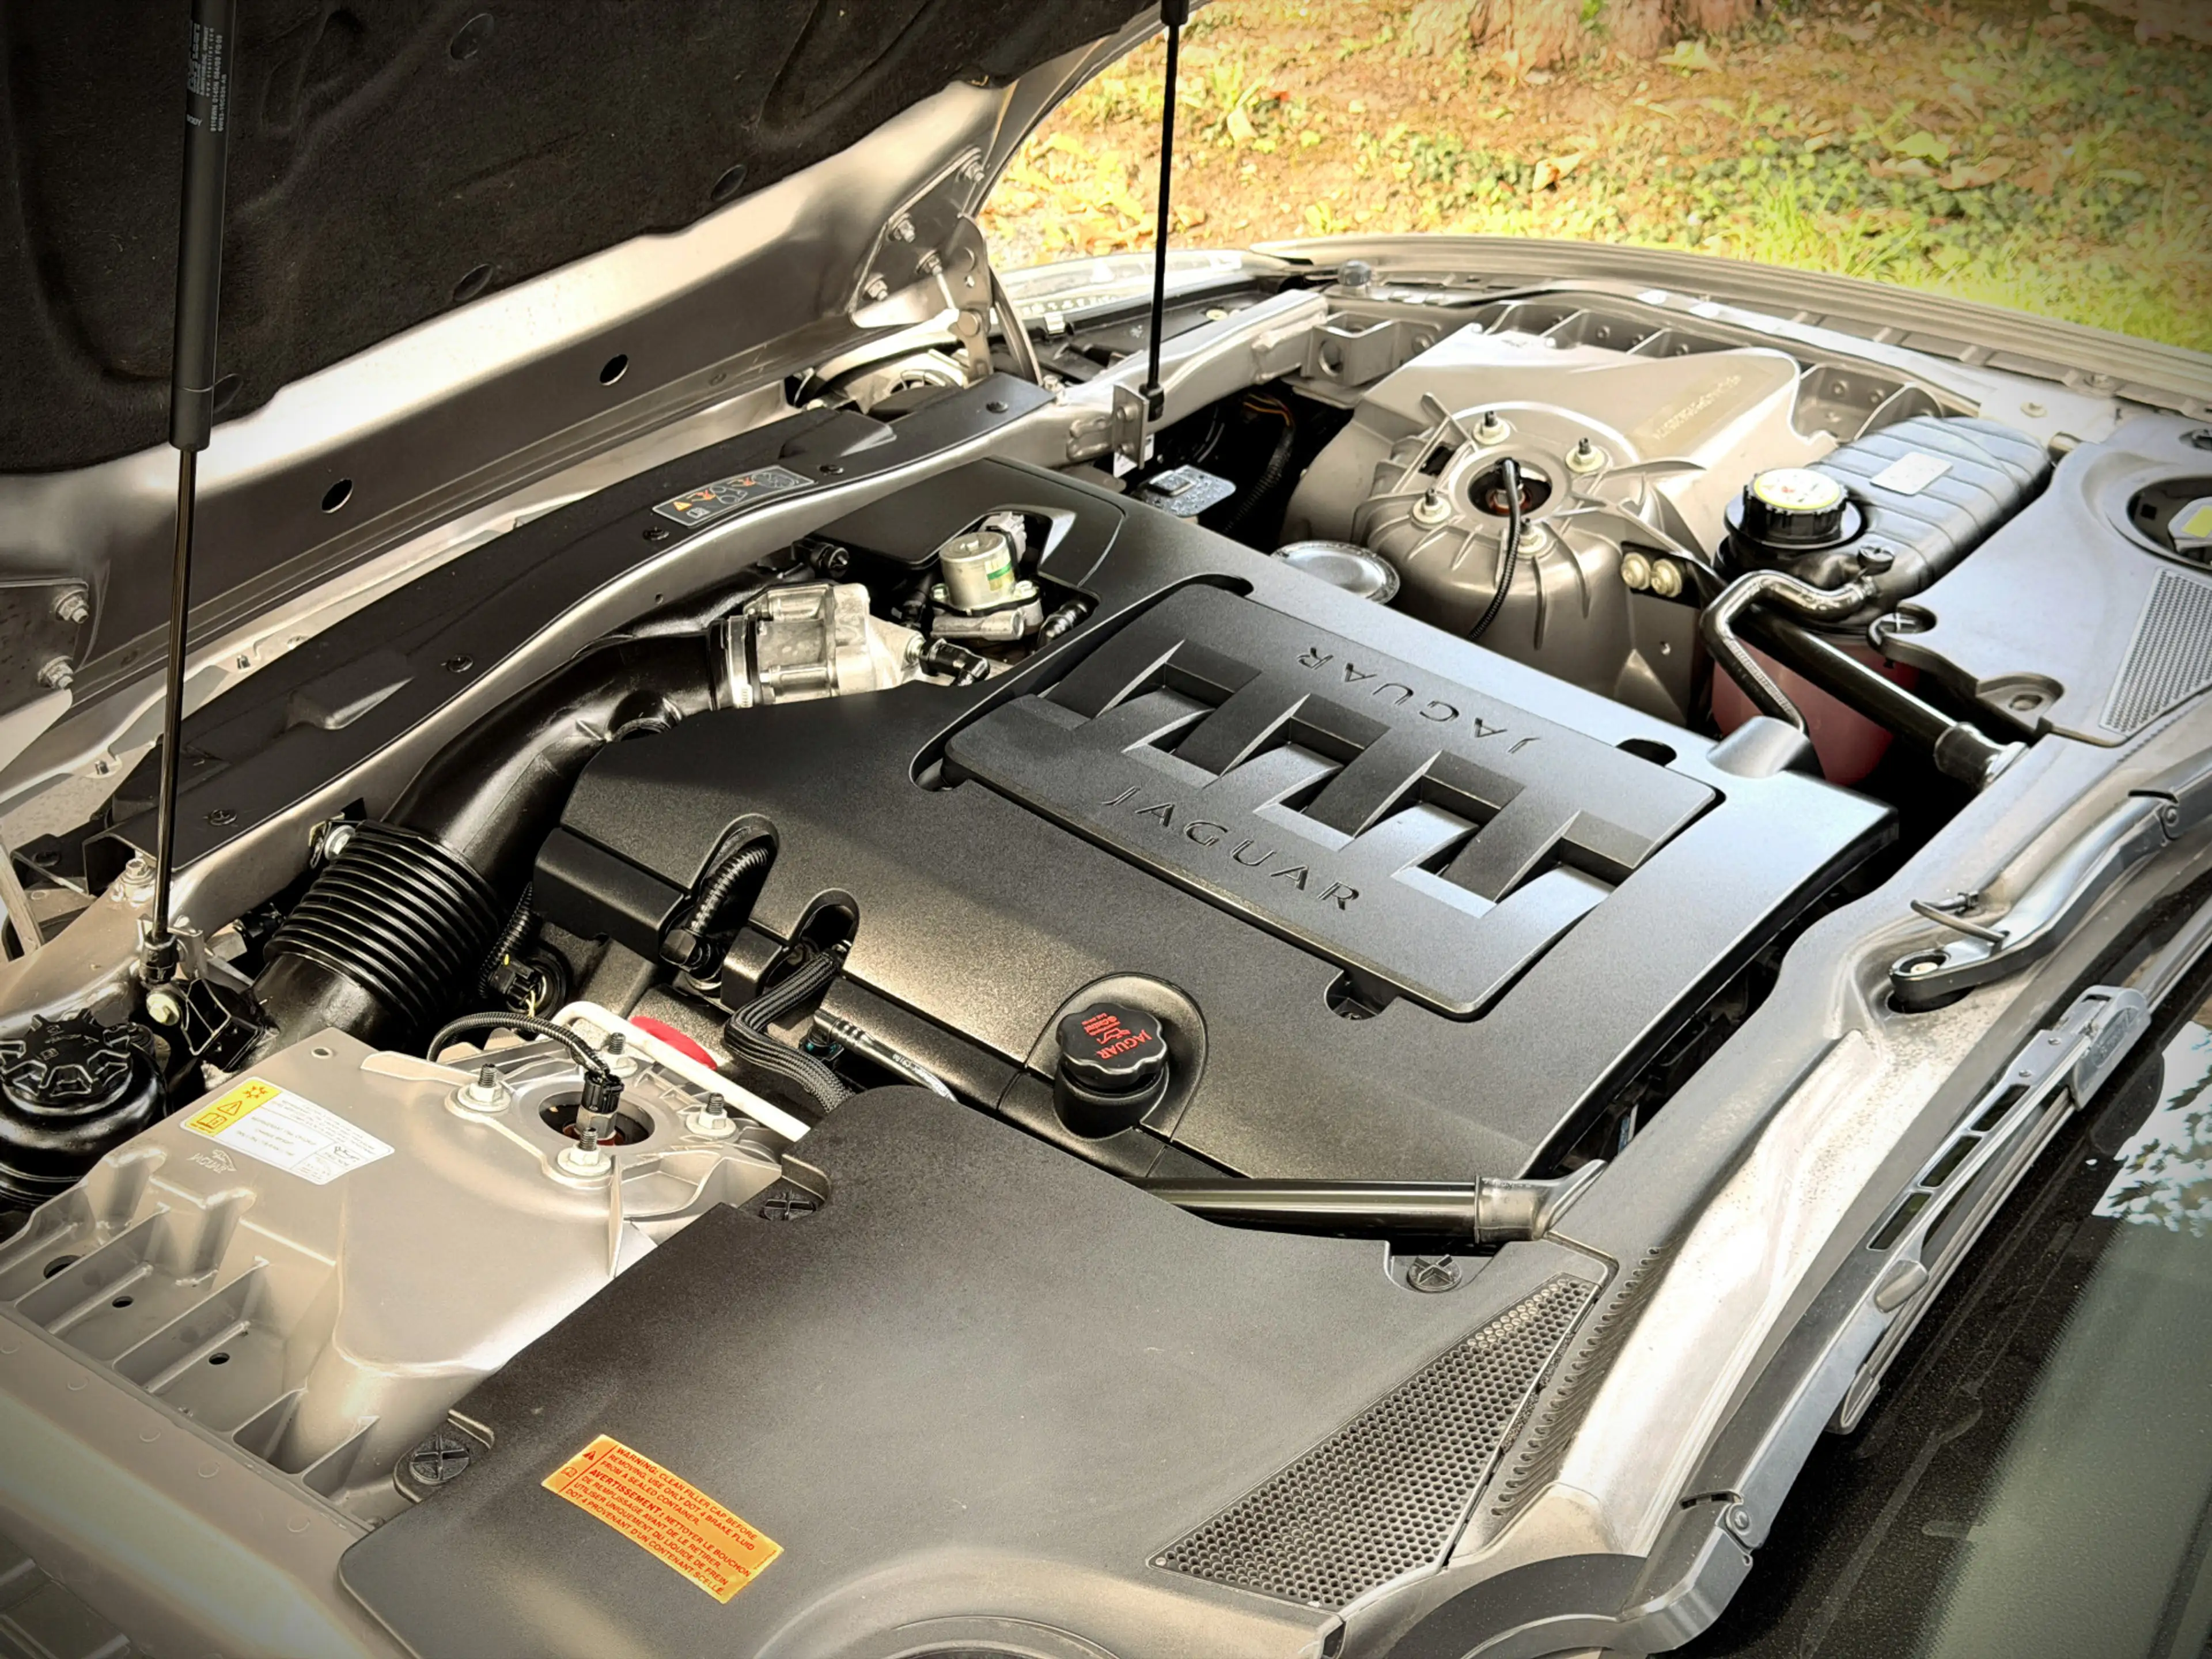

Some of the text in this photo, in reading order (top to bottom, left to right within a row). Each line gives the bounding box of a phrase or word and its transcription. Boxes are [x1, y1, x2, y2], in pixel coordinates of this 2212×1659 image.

[1296, 646, 1542, 753] JAGUAR
[1101, 785, 1360, 911] JAGUAR
[1096, 1029, 1153, 1060] JAGUAR
[581, 1475, 593, 1484] DE
[592, 1482, 643, 1514] REMPLISSAGE
[641, 1513, 667, 1529] AVANT
[665, 1528, 679, 1538] DE
[677, 1536, 688, 1546] LE
[600, 1460, 623, 1475] FROM
[627, 1476, 658, 1496] SEALED
[616, 1448, 757, 1540] WARNING: CLEAN FILLER CAP BEFORE
[647, 1476, 665, 1489] USE
[663, 1487, 684, 1502] ONLY
[683, 1500, 700, 1512] DOT
[704, 1515, 733, 1535] BRAKE
[730, 1533, 755, 1551] FLUID
[565, 1488, 584, 1501] DOT
[586, 1501, 632, 1529] PROVENANT
[647, 1540, 695, 1573] CONTENANT
[573, 1482, 729, 1585] UTILISER UNIQUEMENT DU LIQUIDE DE FREIN
[664, 1515, 704, 1543] NETTOYER
[702, 1541, 715, 1551] LE
[712, 1550, 752, 1577] BOUCHON
